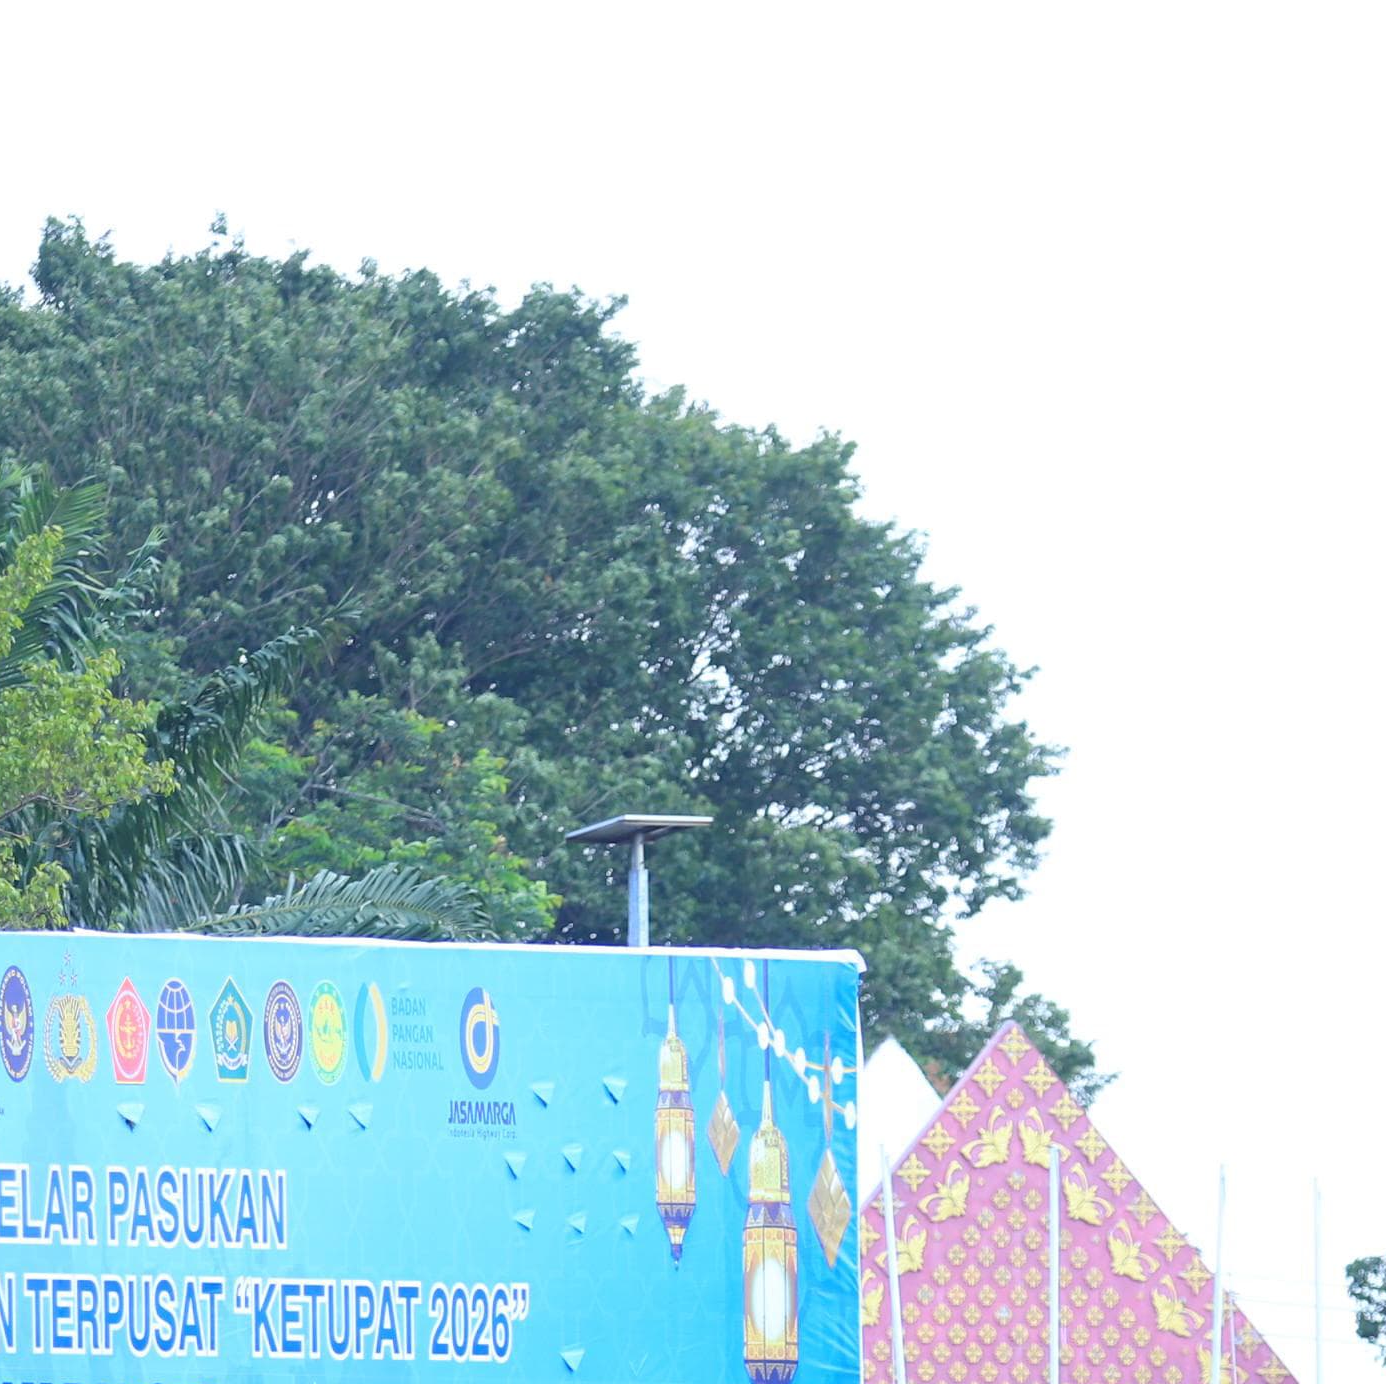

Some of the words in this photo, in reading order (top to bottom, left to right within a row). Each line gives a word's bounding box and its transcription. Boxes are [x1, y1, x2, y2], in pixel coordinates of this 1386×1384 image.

[391, 997, 426, 1017] BADAN
[392, 1024, 433, 1043] PANGAN
[393, 1051, 444, 1071] NASIONAL
[448, 1100, 516, 1126] JASAMARGA
[107, 1165, 288, 1249] PASUKAN
[24, 1271, 225, 1357] TERPUSAT
[234, 1276, 421, 1360] “KETUPAT
[429, 1283, 530, 1363] 2026”
